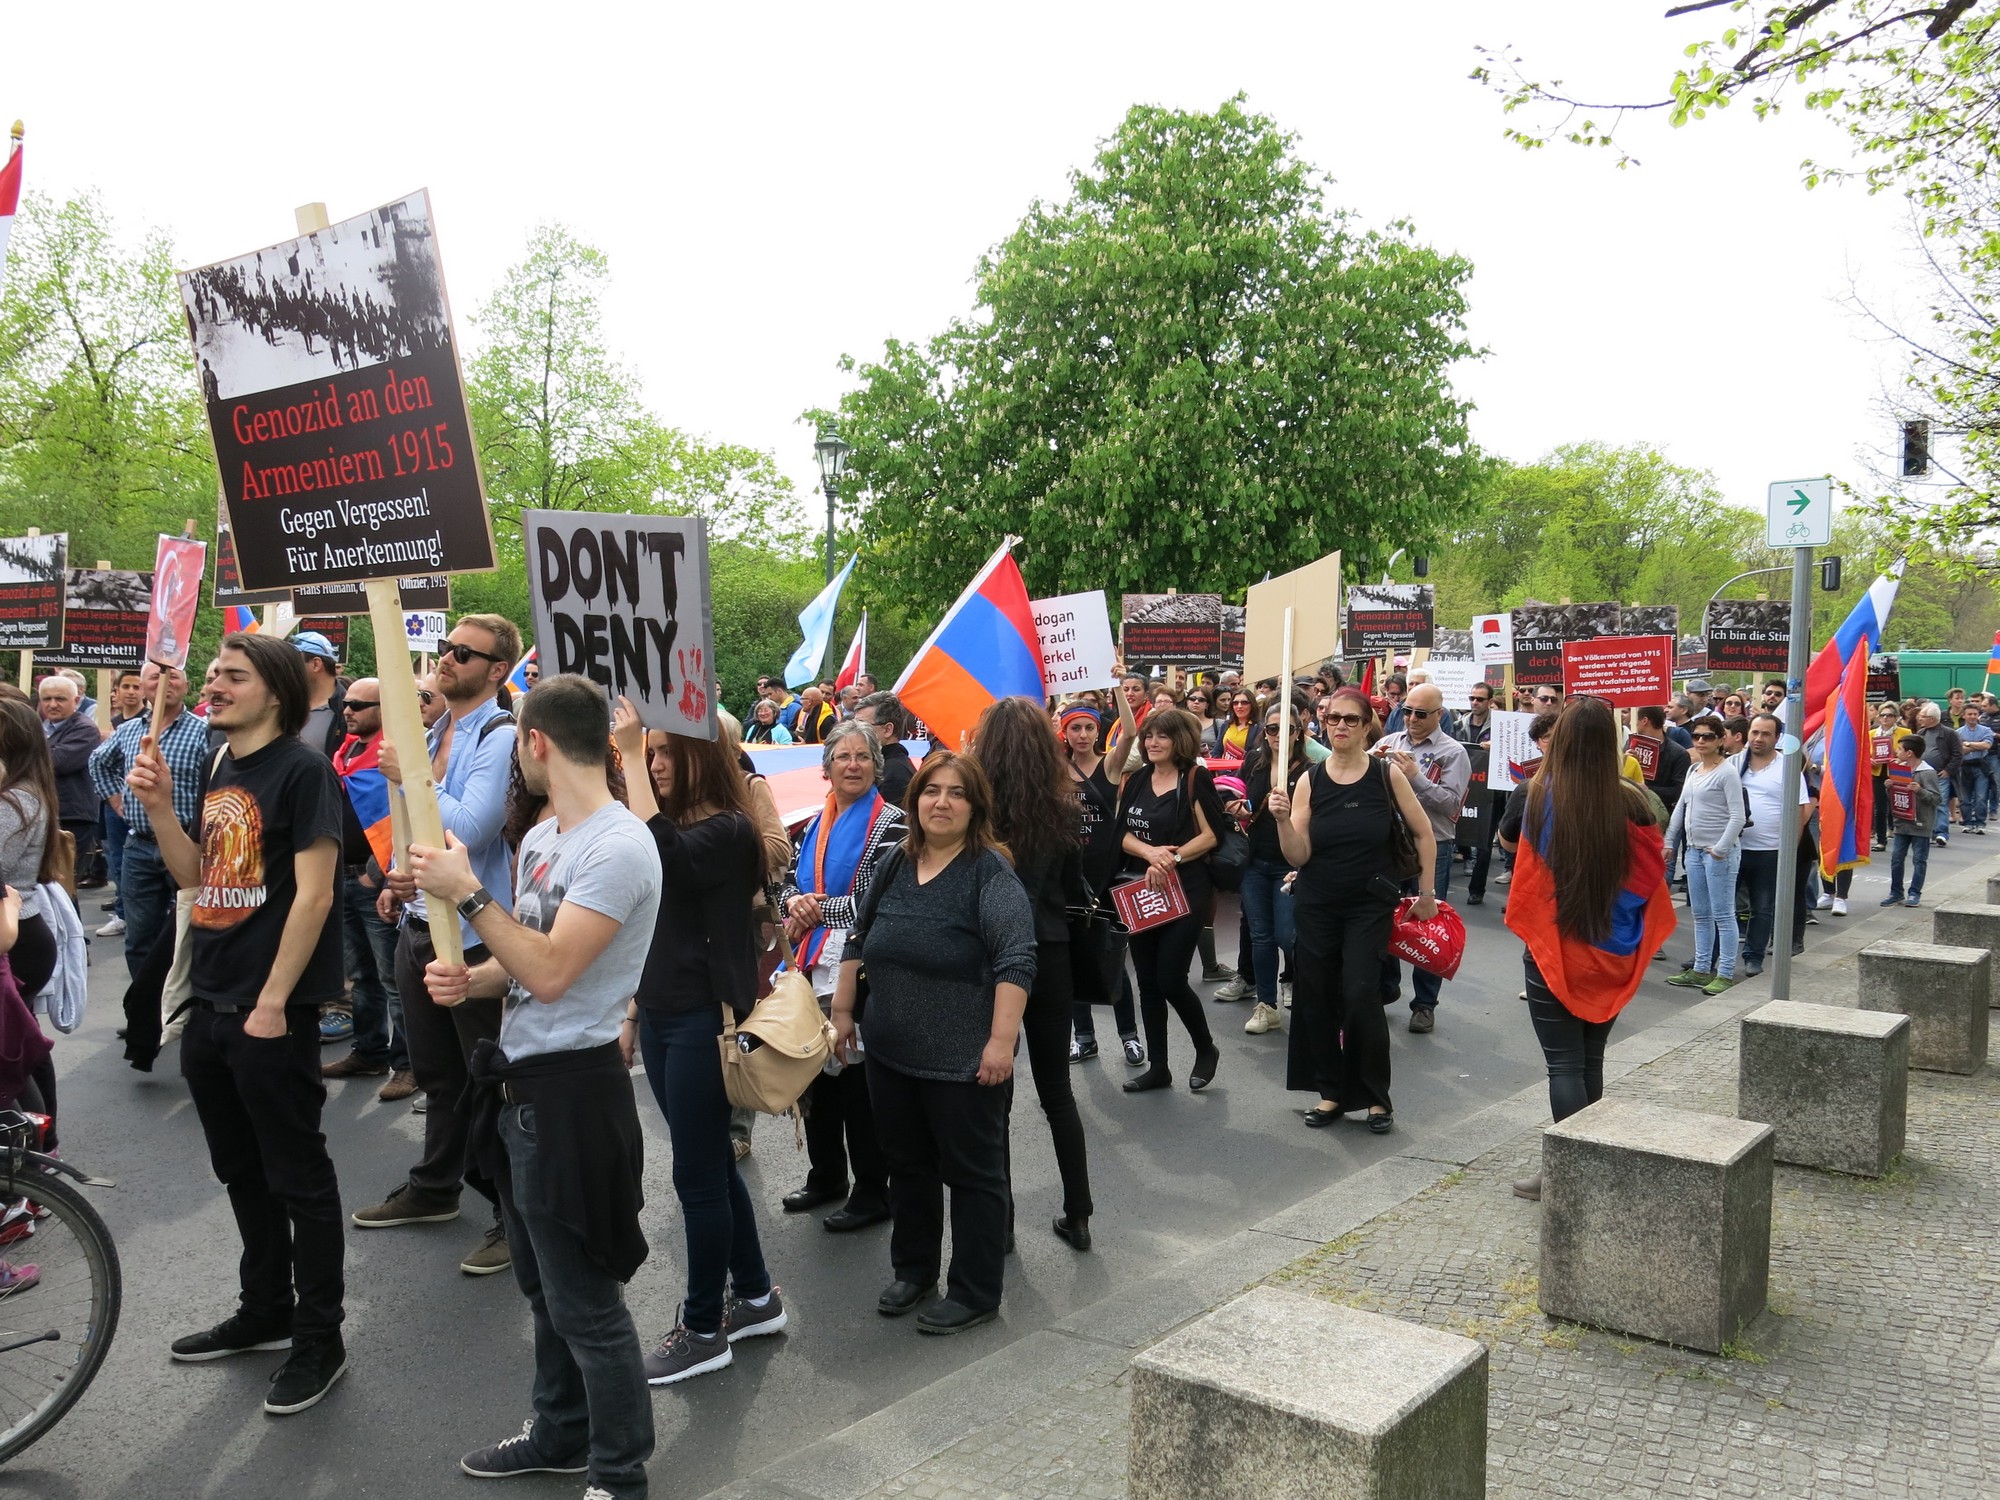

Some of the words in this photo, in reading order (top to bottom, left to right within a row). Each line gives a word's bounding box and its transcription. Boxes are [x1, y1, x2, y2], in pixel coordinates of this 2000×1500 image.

[232, 383, 344, 445] Genozid
[347, 387, 380, 423] an
[384, 369, 433, 415] den
[241, 447, 385, 501] Armeniern
[388, 422, 454, 477] 1915
[280, 507, 337, 538] Gegen
[336, 487, 431, 531] Vergessen!
[286, 546, 319, 573] Für
[324, 529, 444, 567] Anerkennung!
[537, 526, 685, 620] DON'T
[431, 575, 448, 588] 1915
[0, 584, 28, 600] enozid
[0, 605, 36, 619] meniern
[38, 602, 59, 617] 1915
[1354, 611, 1391, 620] Genozid
[1392, 612, 1405, 620] an
[1406, 611, 1423, 620] den
[425, 615, 443, 633] 100
[1033, 611, 1075, 628] dogan
[1353, 622, 1403, 631] Armeniern
[1404, 621, 1428, 631] 1915
[18, 621, 48, 635] Vergessen!
[66, 622, 100, 633] ugnung
[1143, 627, 1174, 635] Armenier
[1175, 627, 1201, 635] wurden
[9, 635, 49, 648] Anerkennung!
[1050, 628, 1076, 644] auf!
[1363, 632, 1382, 640] Gegen
[1383, 631, 1415, 640] Vergessen!
[1709, 630, 1728, 640] Ich
[1729, 630, 1747, 641] bin
[1749, 631, 1766, 641] die
[71, 643, 85, 654] Es
[89, 644, 137, 656] reicht!!!
[1374, 639, 1417, 648] Anerkennung!
[1515, 640, 1533, 651] Ich
[1535, 639, 1554, 651] bin
[1043, 648, 1076, 665] erkel
[1568, 655, 1583, 663] Den
[1584, 651, 1627, 662] Völkermord
[1643, 649, 1661, 657] 1915
[1722, 645, 1740, 655] der
[1743, 644, 1770, 657] Opfer
[1776, 646, 1789, 656] de
[81, 656, 102, 664] muss
[103, 656, 137, 666] Klarwort
[553, 612, 679, 705] DENY
[1429, 653, 1443, 662] Ich
[1443, 653, 1459, 662] bin
[1459, 653, 1474, 662] die
[1529, 655, 1549, 667] der
[1579, 662, 1605, 670] werden
[1606, 660, 1618, 668] wir
[1619, 658, 1651, 669] nirgends
[1709, 658, 1757, 670] Genozids
[1759, 661, 1779, 670] von
[1044, 670, 1058, 684] ch
[1061, 665, 1089, 682] auf!
[1579, 670, 1614, 679] tolerieren
[1571, 680, 1598, 688] unserer
[1598, 676, 1635, 686] Vorfahren
[1635, 676, 1647, 684] für
[1647, 675, 1660, 683] die
[1572, 686, 1622, 696] Anerkennung
[1622, 684, 1660, 693] salutieren.
[1471, 771, 1486, 782] rd
[1462, 805, 1478, 818] kei
[1127, 818, 1150, 829] UNDS
[212, 887, 221, 908] A
[222, 885, 267, 909] DOWN
[1428, 922, 1450, 942] offe
[1418, 935, 1441, 955] offe
